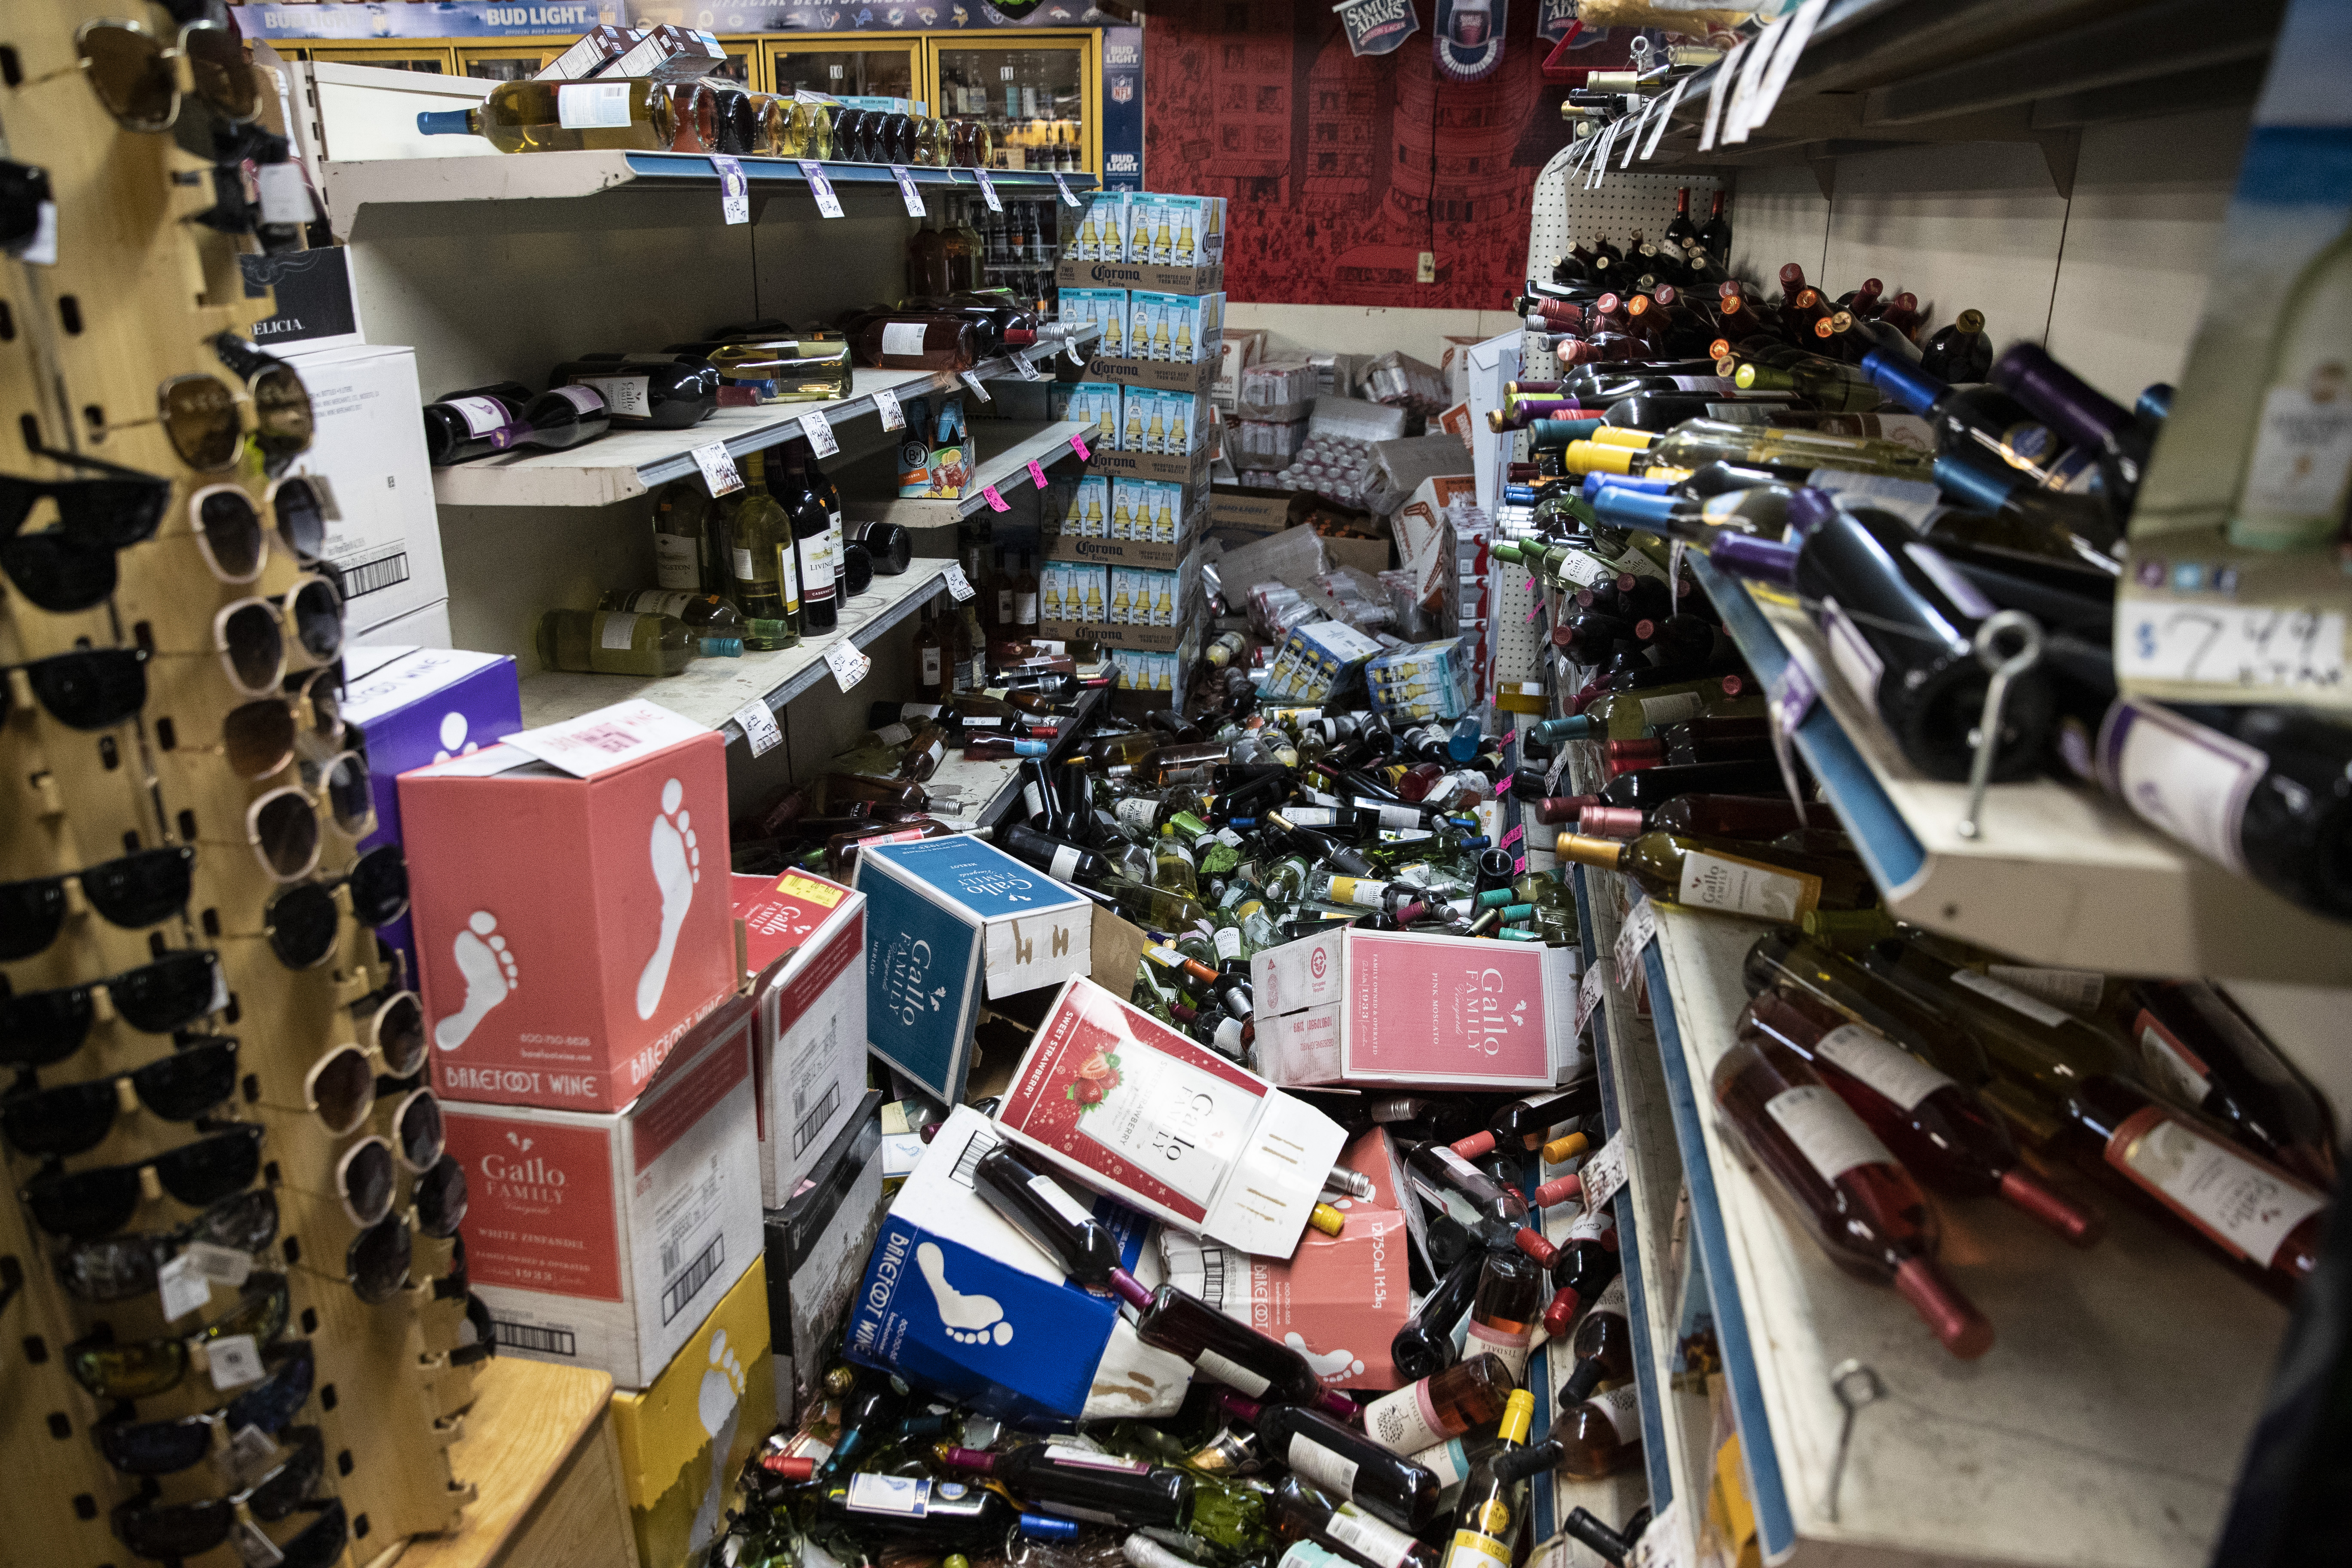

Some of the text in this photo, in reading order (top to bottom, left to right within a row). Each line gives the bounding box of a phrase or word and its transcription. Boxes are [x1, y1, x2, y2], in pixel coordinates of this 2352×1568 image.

[487, 6, 586, 26] BUD LIGHT
[1357, 3, 1405, 39] ADAMS
[1547, 3, 1578, 21] ADA
[1106, 54, 1138, 64] LIGHT
[1111, 46, 1133, 55] BUD
[830, 65, 842, 79] 10
[1002, 67, 1012, 79] 11
[1112, 86, 1132, 99] NFL
[1106, 162, 1138, 172] LIGHT
[1110, 154, 1134, 163] BUD
[1091, 265, 1140, 282] Corona
[1154, 347, 1171, 356] Corona
[1175, 350, 1192, 358] Corona
[1090, 360, 1139, 377] Corona
[627, 382, 636, 410] Gallo
[1088, 451, 1136, 469] Corona
[1075, 541, 1123, 556] Corona
[810, 560, 833, 571] LIVINGS
[1569, 555, 1586, 577] Gallo
[1075, 627, 1123, 641] Corona
[827, 644, 846, 658] LIVINGSTON
[738, 702, 761, 719] LIVINGSTON
[958, 870, 1017, 887] FAMILY
[966, 879, 1033, 894] Gallo
[1701, 865, 1720, 904] Gallo
[1370, 885, 1380, 903] Gallo
[748, 901, 779, 930] FAMILY
[761, 906, 802, 936] Gallo
[1217, 932, 1236, 941] Gallo
[870, 940, 879, 977] MERLOT
[889, 931, 911, 1016] FAMILY
[903, 939, 932, 1026] Gallo
[1465, 970, 1481, 1054] FAMILY
[1480, 967, 1509, 1056] Gallo
[1023, 1011, 1074, 1099] SWEET STRAWBERRY
[445, 1066, 597, 1097] BAREFOOT WINE
[1119, 1090, 1153, 1147] STRAWBERRY
[1166, 1093, 1214, 1162] Gallo
[481, 1155, 566, 1186] Gallo
[486, 1182, 564, 1204] FAMILY
[479, 1228, 585, 1249] WHITE ZINFANDEL
[515, 1268, 552, 1281] 1933
[853, 1231, 910, 1357] BAREFOOT WINE
[1254, 1265, 1269, 1328] BAREFOOT
[1409, 1395, 1426, 1433] TISDALE
